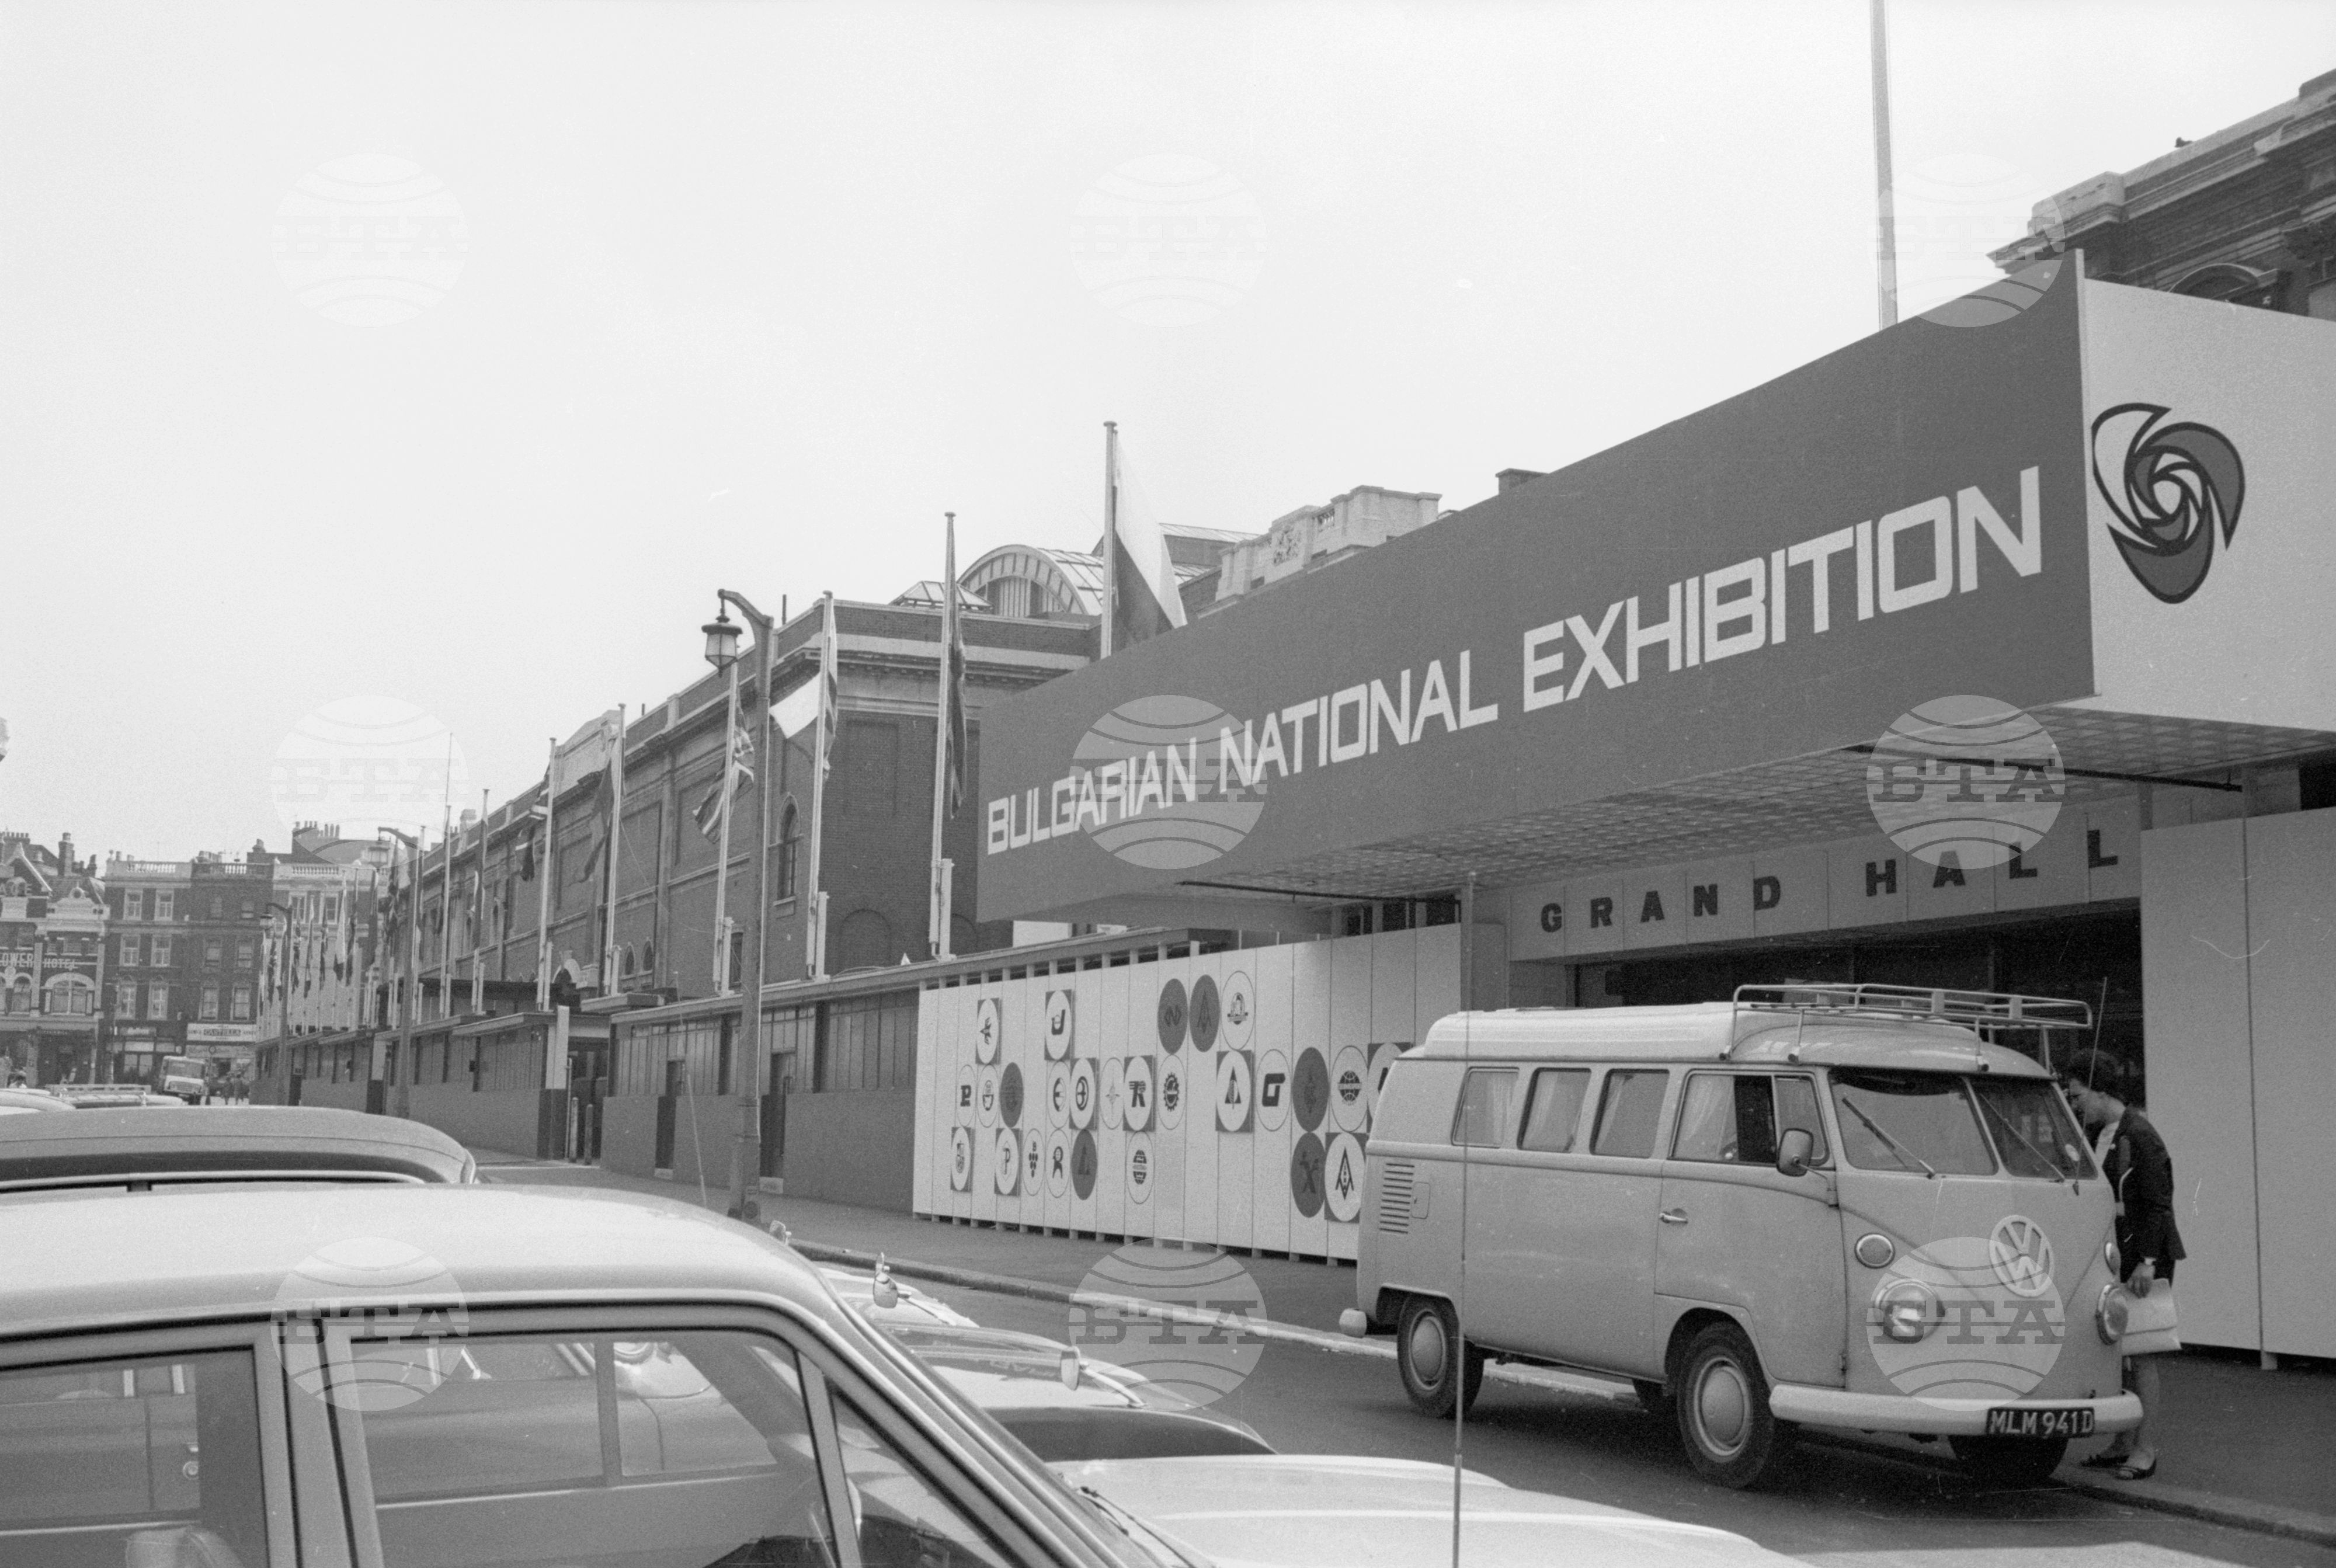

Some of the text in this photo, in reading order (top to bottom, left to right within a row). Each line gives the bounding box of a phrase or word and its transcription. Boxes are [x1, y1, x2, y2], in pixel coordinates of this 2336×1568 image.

[988, 466, 2042, 856] BULGARIAN NATIONAL EXHIBITION
[1540, 829, 2118, 933] GRAND HALL
[0, 952, 78, 969] OWER HOTEL
[1989, 1410, 2094, 1438] MLM 941D
